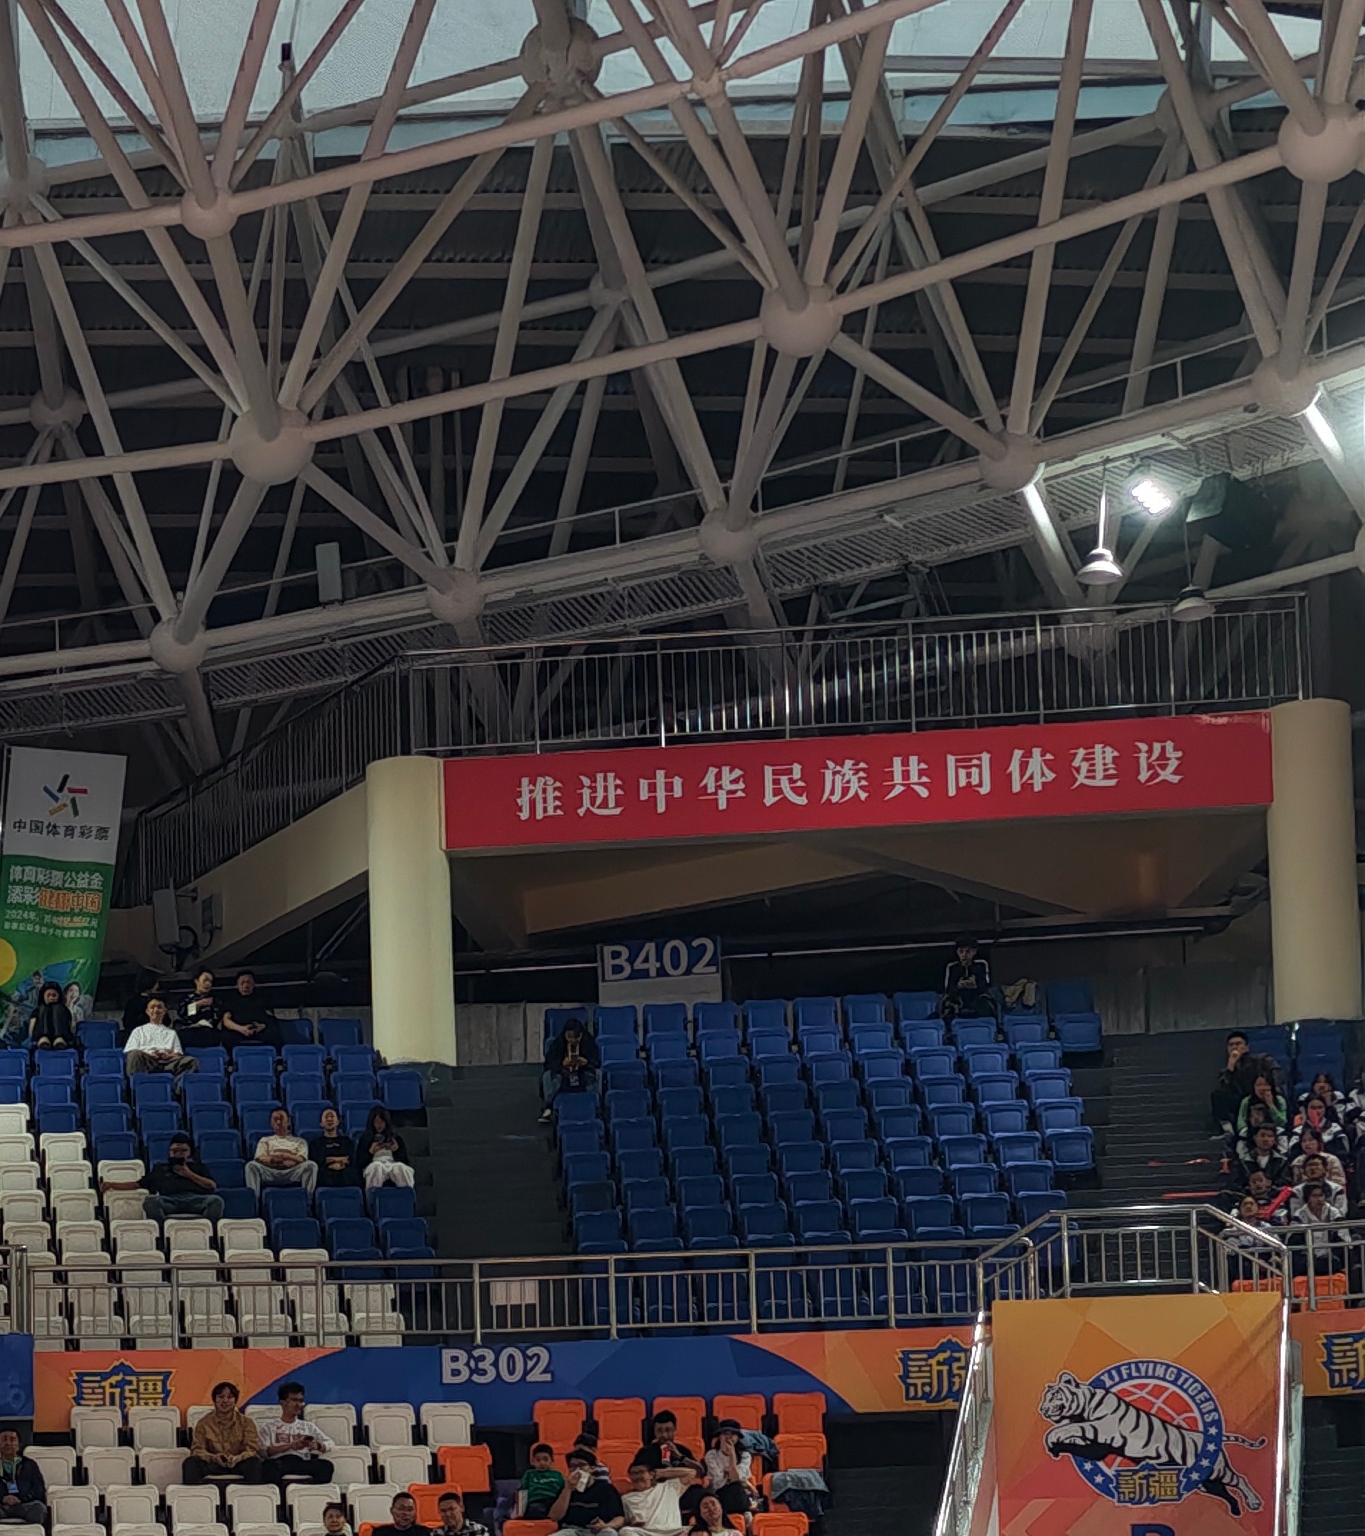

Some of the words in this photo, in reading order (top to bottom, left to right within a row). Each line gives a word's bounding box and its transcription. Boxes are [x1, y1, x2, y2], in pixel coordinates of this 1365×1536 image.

[515, 739, 1185, 822] 推进中华民族共同体建设
[12, 818, 111, 841] 中国体育彩票
[602, 936, 720, 981] B402
[440, 1345, 554, 1385] B302
[1120, 1361, 1177, 1382] FLYING
[1174, 1369, 1218, 1424] TIGERS
[1115, 1470, 1181, 1502] 新疆
